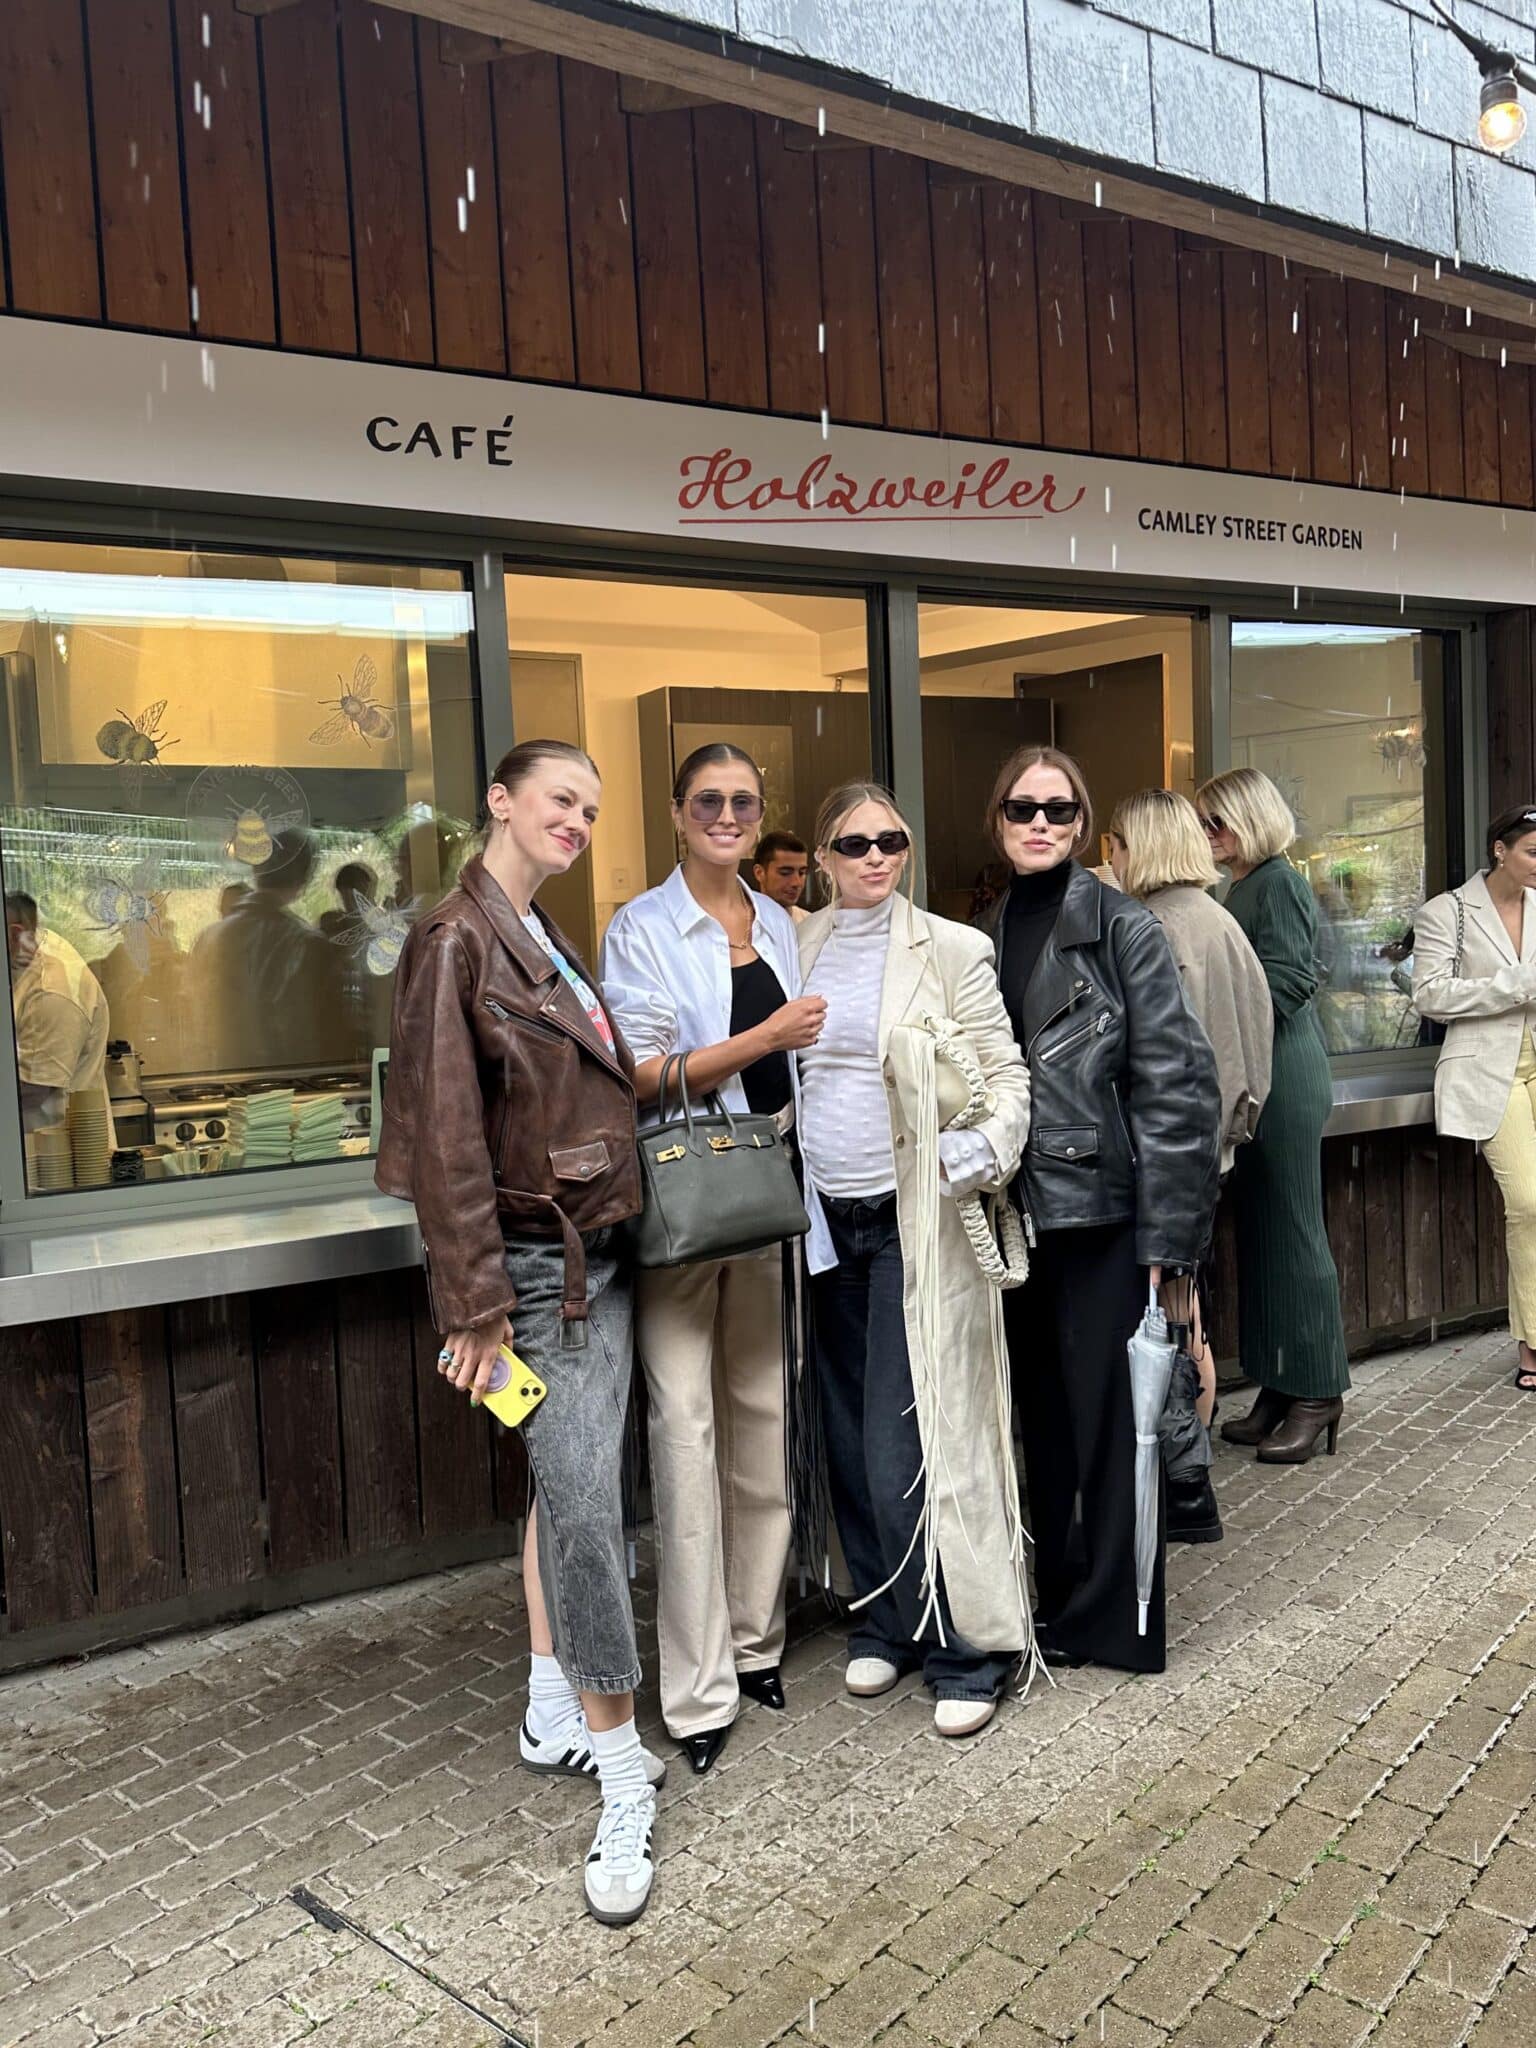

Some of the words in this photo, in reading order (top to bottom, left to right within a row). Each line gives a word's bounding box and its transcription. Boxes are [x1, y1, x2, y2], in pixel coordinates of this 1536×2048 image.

[365, 414, 514, 467] CAFÉ
[678, 448, 1086, 515] Holzweiler
[1137, 507, 1218, 536] CAMLEY
[1222, 515, 1288, 543] STREET
[1291, 523, 1363, 551] GARDEN
[264, 768, 300, 803] BEES
